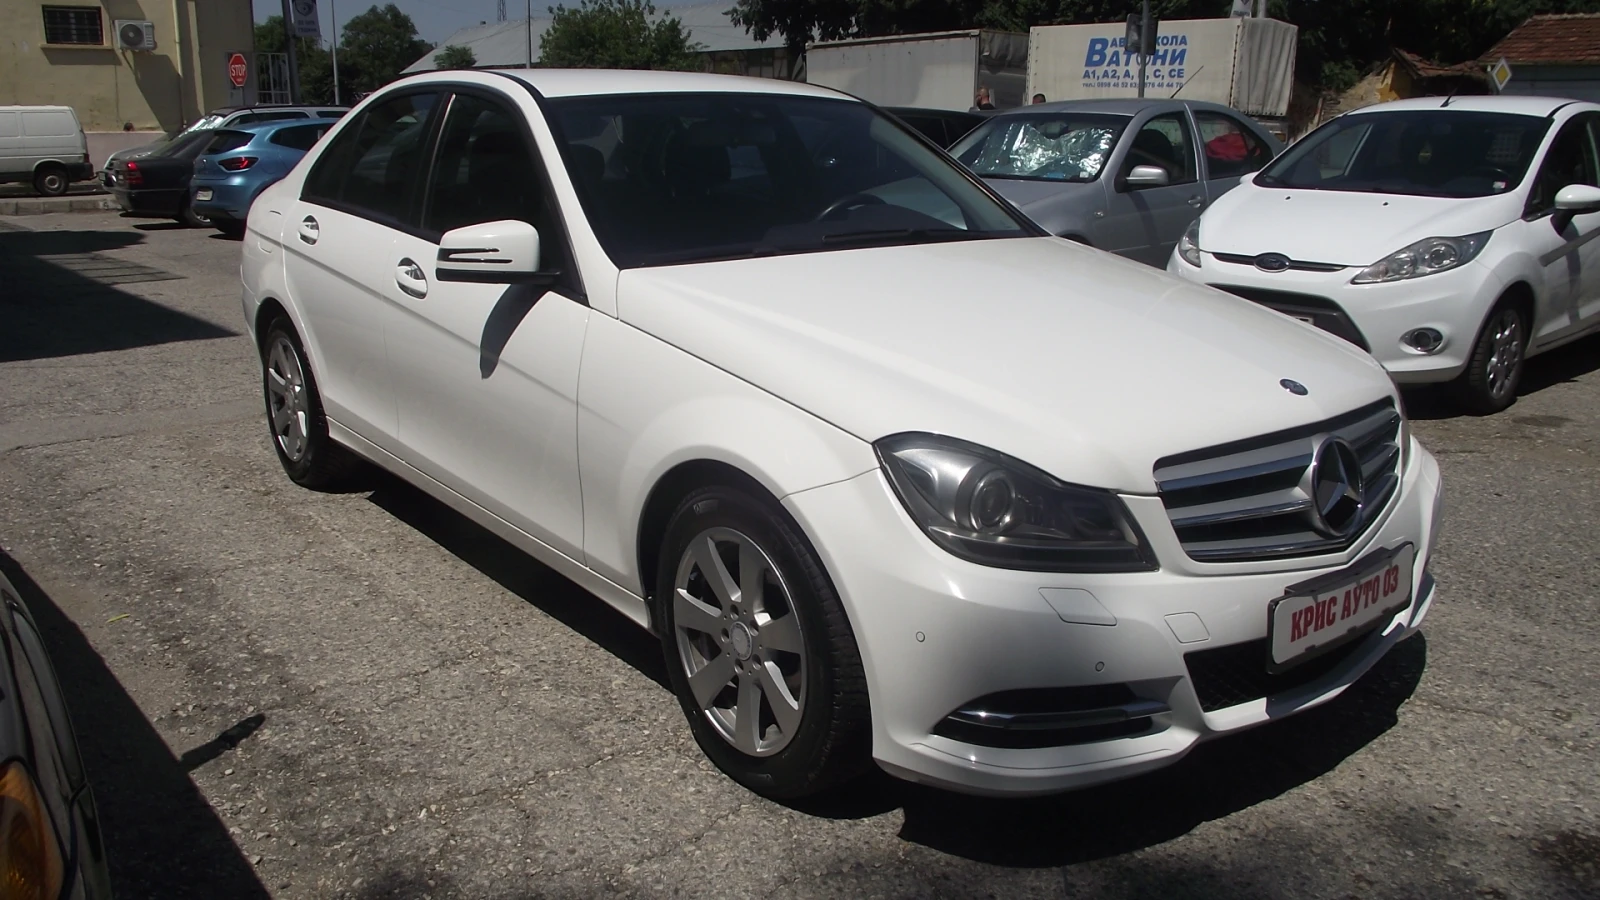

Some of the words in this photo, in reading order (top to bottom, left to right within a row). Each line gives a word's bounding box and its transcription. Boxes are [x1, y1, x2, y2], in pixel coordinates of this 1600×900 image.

[1110, 35, 1187, 48] АВКОЛА
[231, 64, 246, 77] STOP
[1290, 596, 1337, 643] КРИС
[1341, 575, 1380, 620] АУТО
